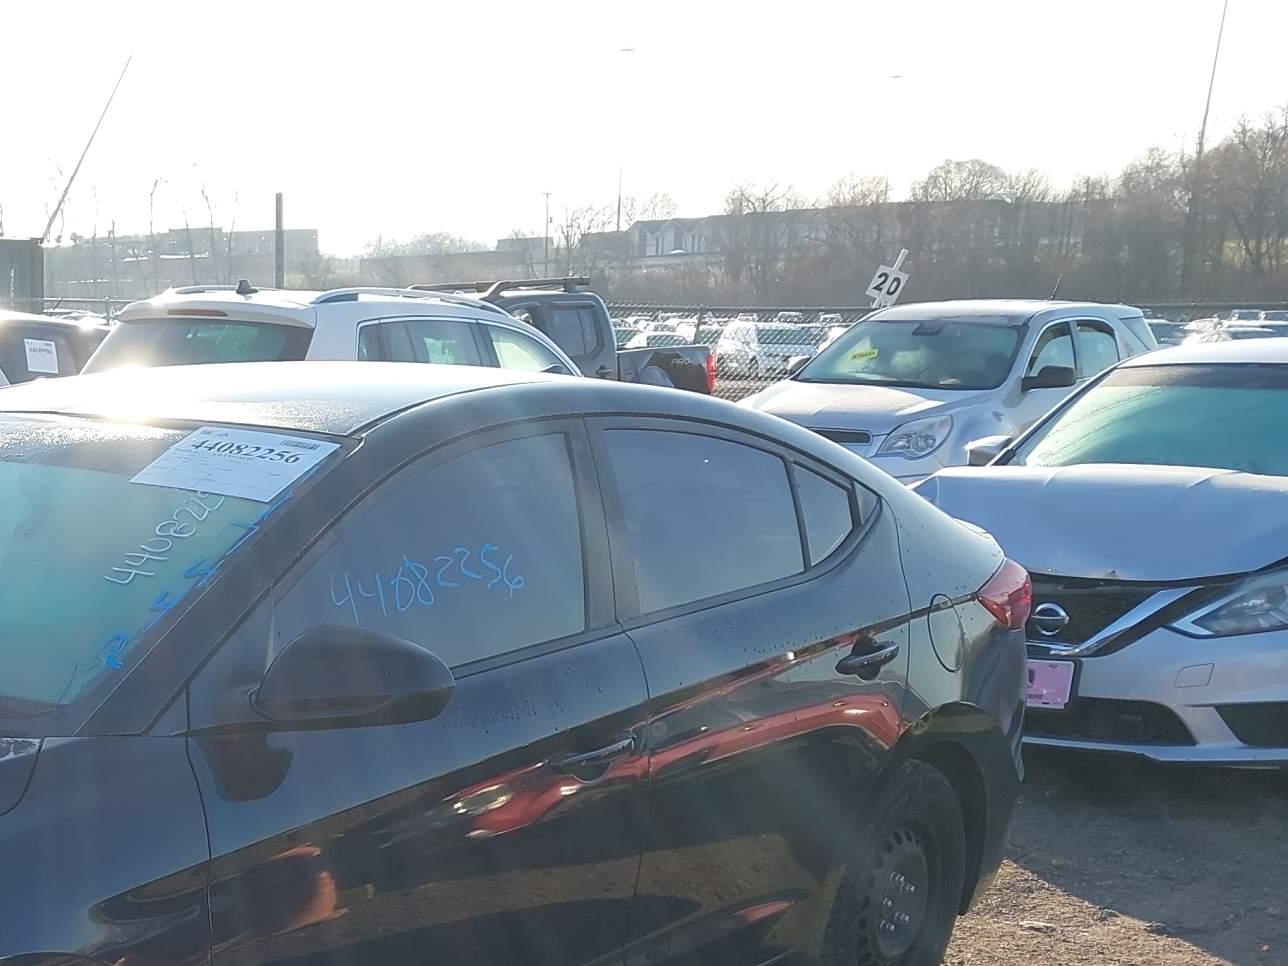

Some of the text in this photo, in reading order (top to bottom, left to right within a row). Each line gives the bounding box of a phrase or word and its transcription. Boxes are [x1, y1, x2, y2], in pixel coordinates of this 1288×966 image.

[872, 272, 901, 296] 20
[191, 438, 304, 465] 44082256
[329, 543, 525, 624] 44082256
